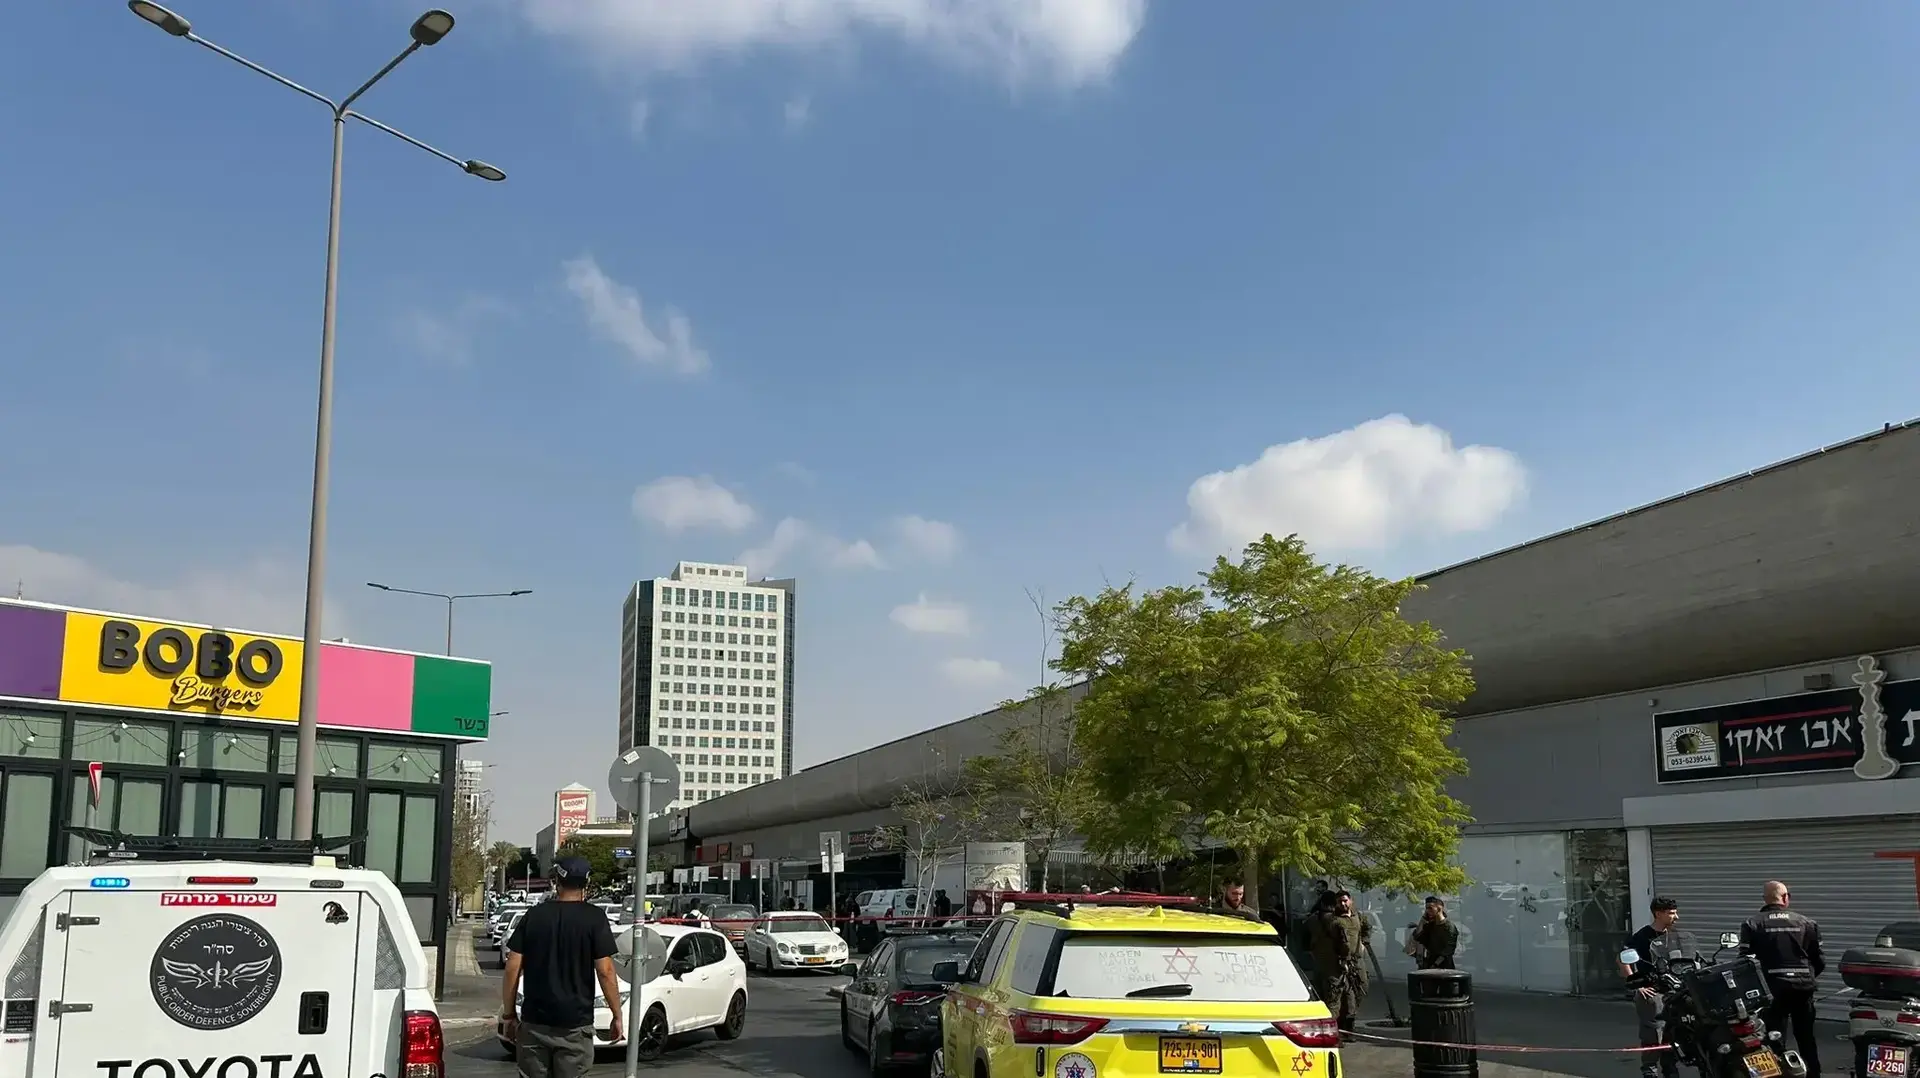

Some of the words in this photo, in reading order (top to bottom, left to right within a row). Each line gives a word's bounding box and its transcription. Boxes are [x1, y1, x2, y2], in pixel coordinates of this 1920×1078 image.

[100, 620, 283, 684] BOBO
[172, 676, 264, 709] Burgers
[454, 717, 486, 731] כשר
[1801, 716, 1852, 749] אבו
[1725, 724, 1787, 767] זאקי
[163, 893, 219, 905] מרחק
[225, 893, 274, 904] שמור
[254, 932, 269, 948] סדר
[157, 975, 173, 1003] PUBLIC
[169, 1002, 195, 1022] ORDER
[195, 1015, 236, 1025] DEFENCE
[236, 972, 276, 1019] SOVEREIGNTY
[97, 1054, 324, 1078] TOYOTA
